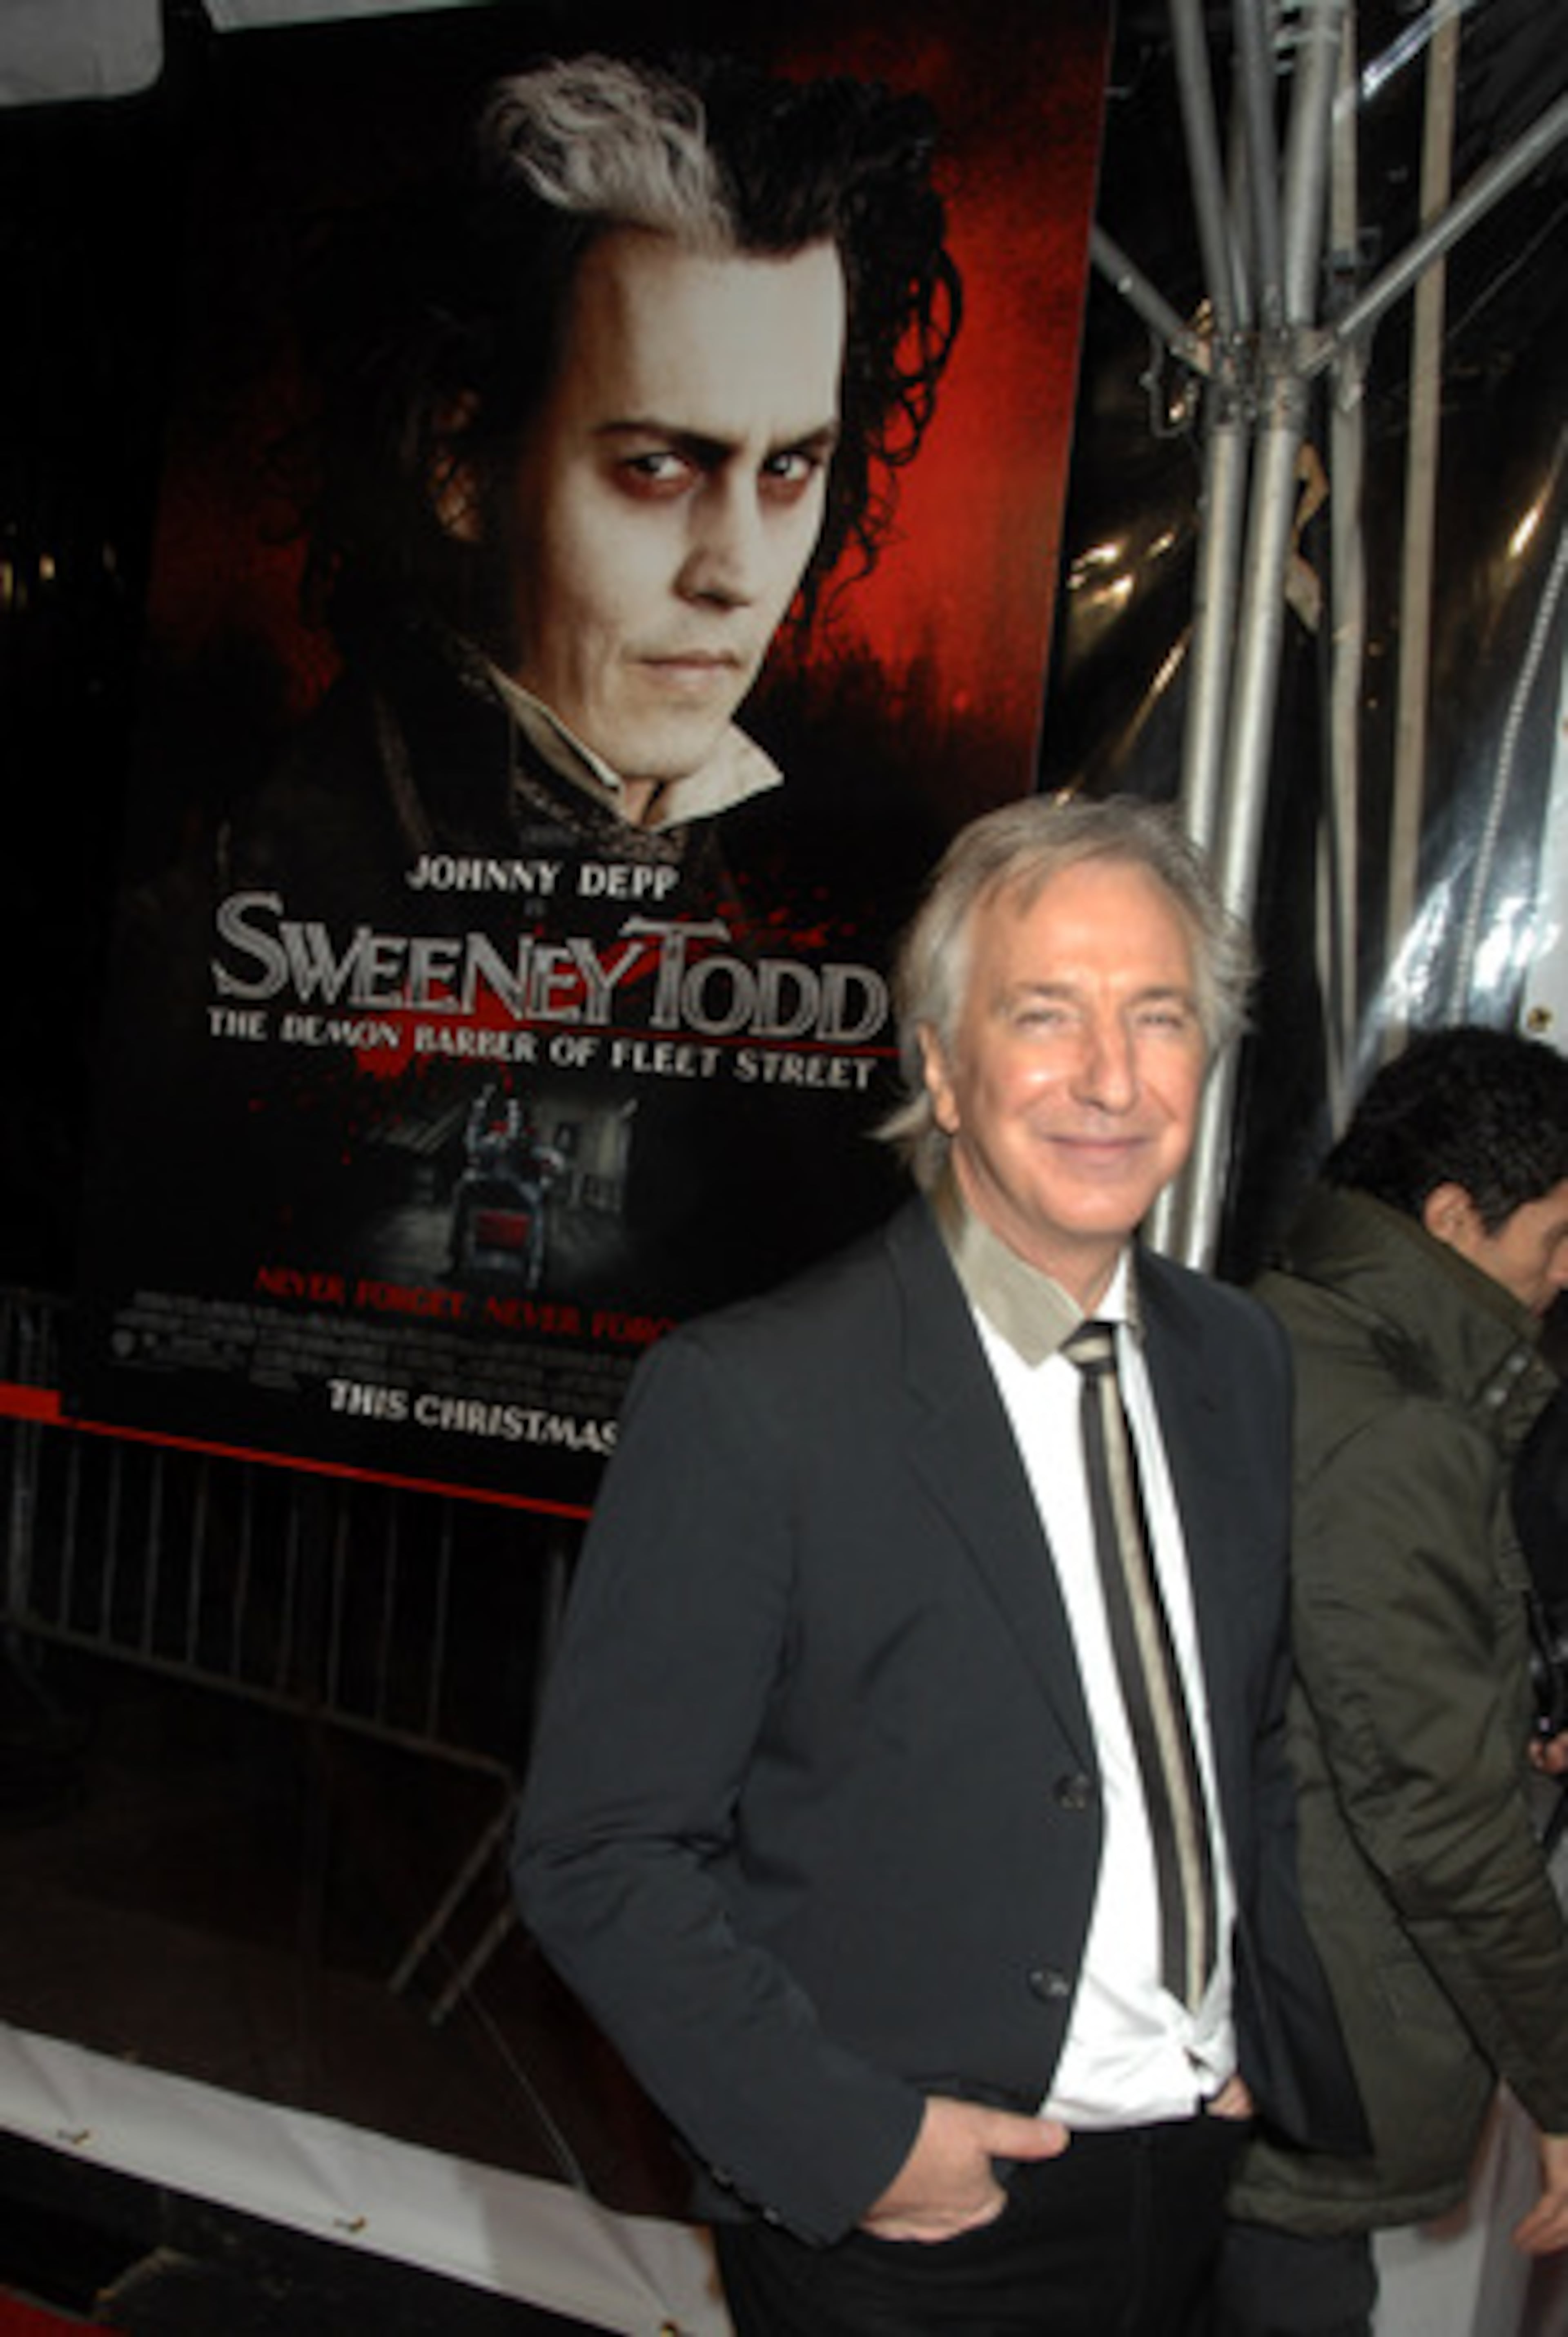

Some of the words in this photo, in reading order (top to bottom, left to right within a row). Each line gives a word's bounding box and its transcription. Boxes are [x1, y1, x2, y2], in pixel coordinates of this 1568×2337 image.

[406, 855, 561, 896] JOHNNY
[578, 863, 679, 900] DEPP
[210, 890, 646, 1025] SWEENEY
[617, 916, 890, 1043] TODD
[207, 1006, 268, 1041] THE
[279, 1013, 402, 1050] DEMON
[413, 1024, 538, 1063] BARBER
[548, 1036, 599, 1068] OF
[611, 1040, 722, 1077] FLEET
[735, 1048, 878, 1090] STREET
[328, 1378, 408, 1422] THIS
[413, 1394, 619, 1456] CHRISTMAS
